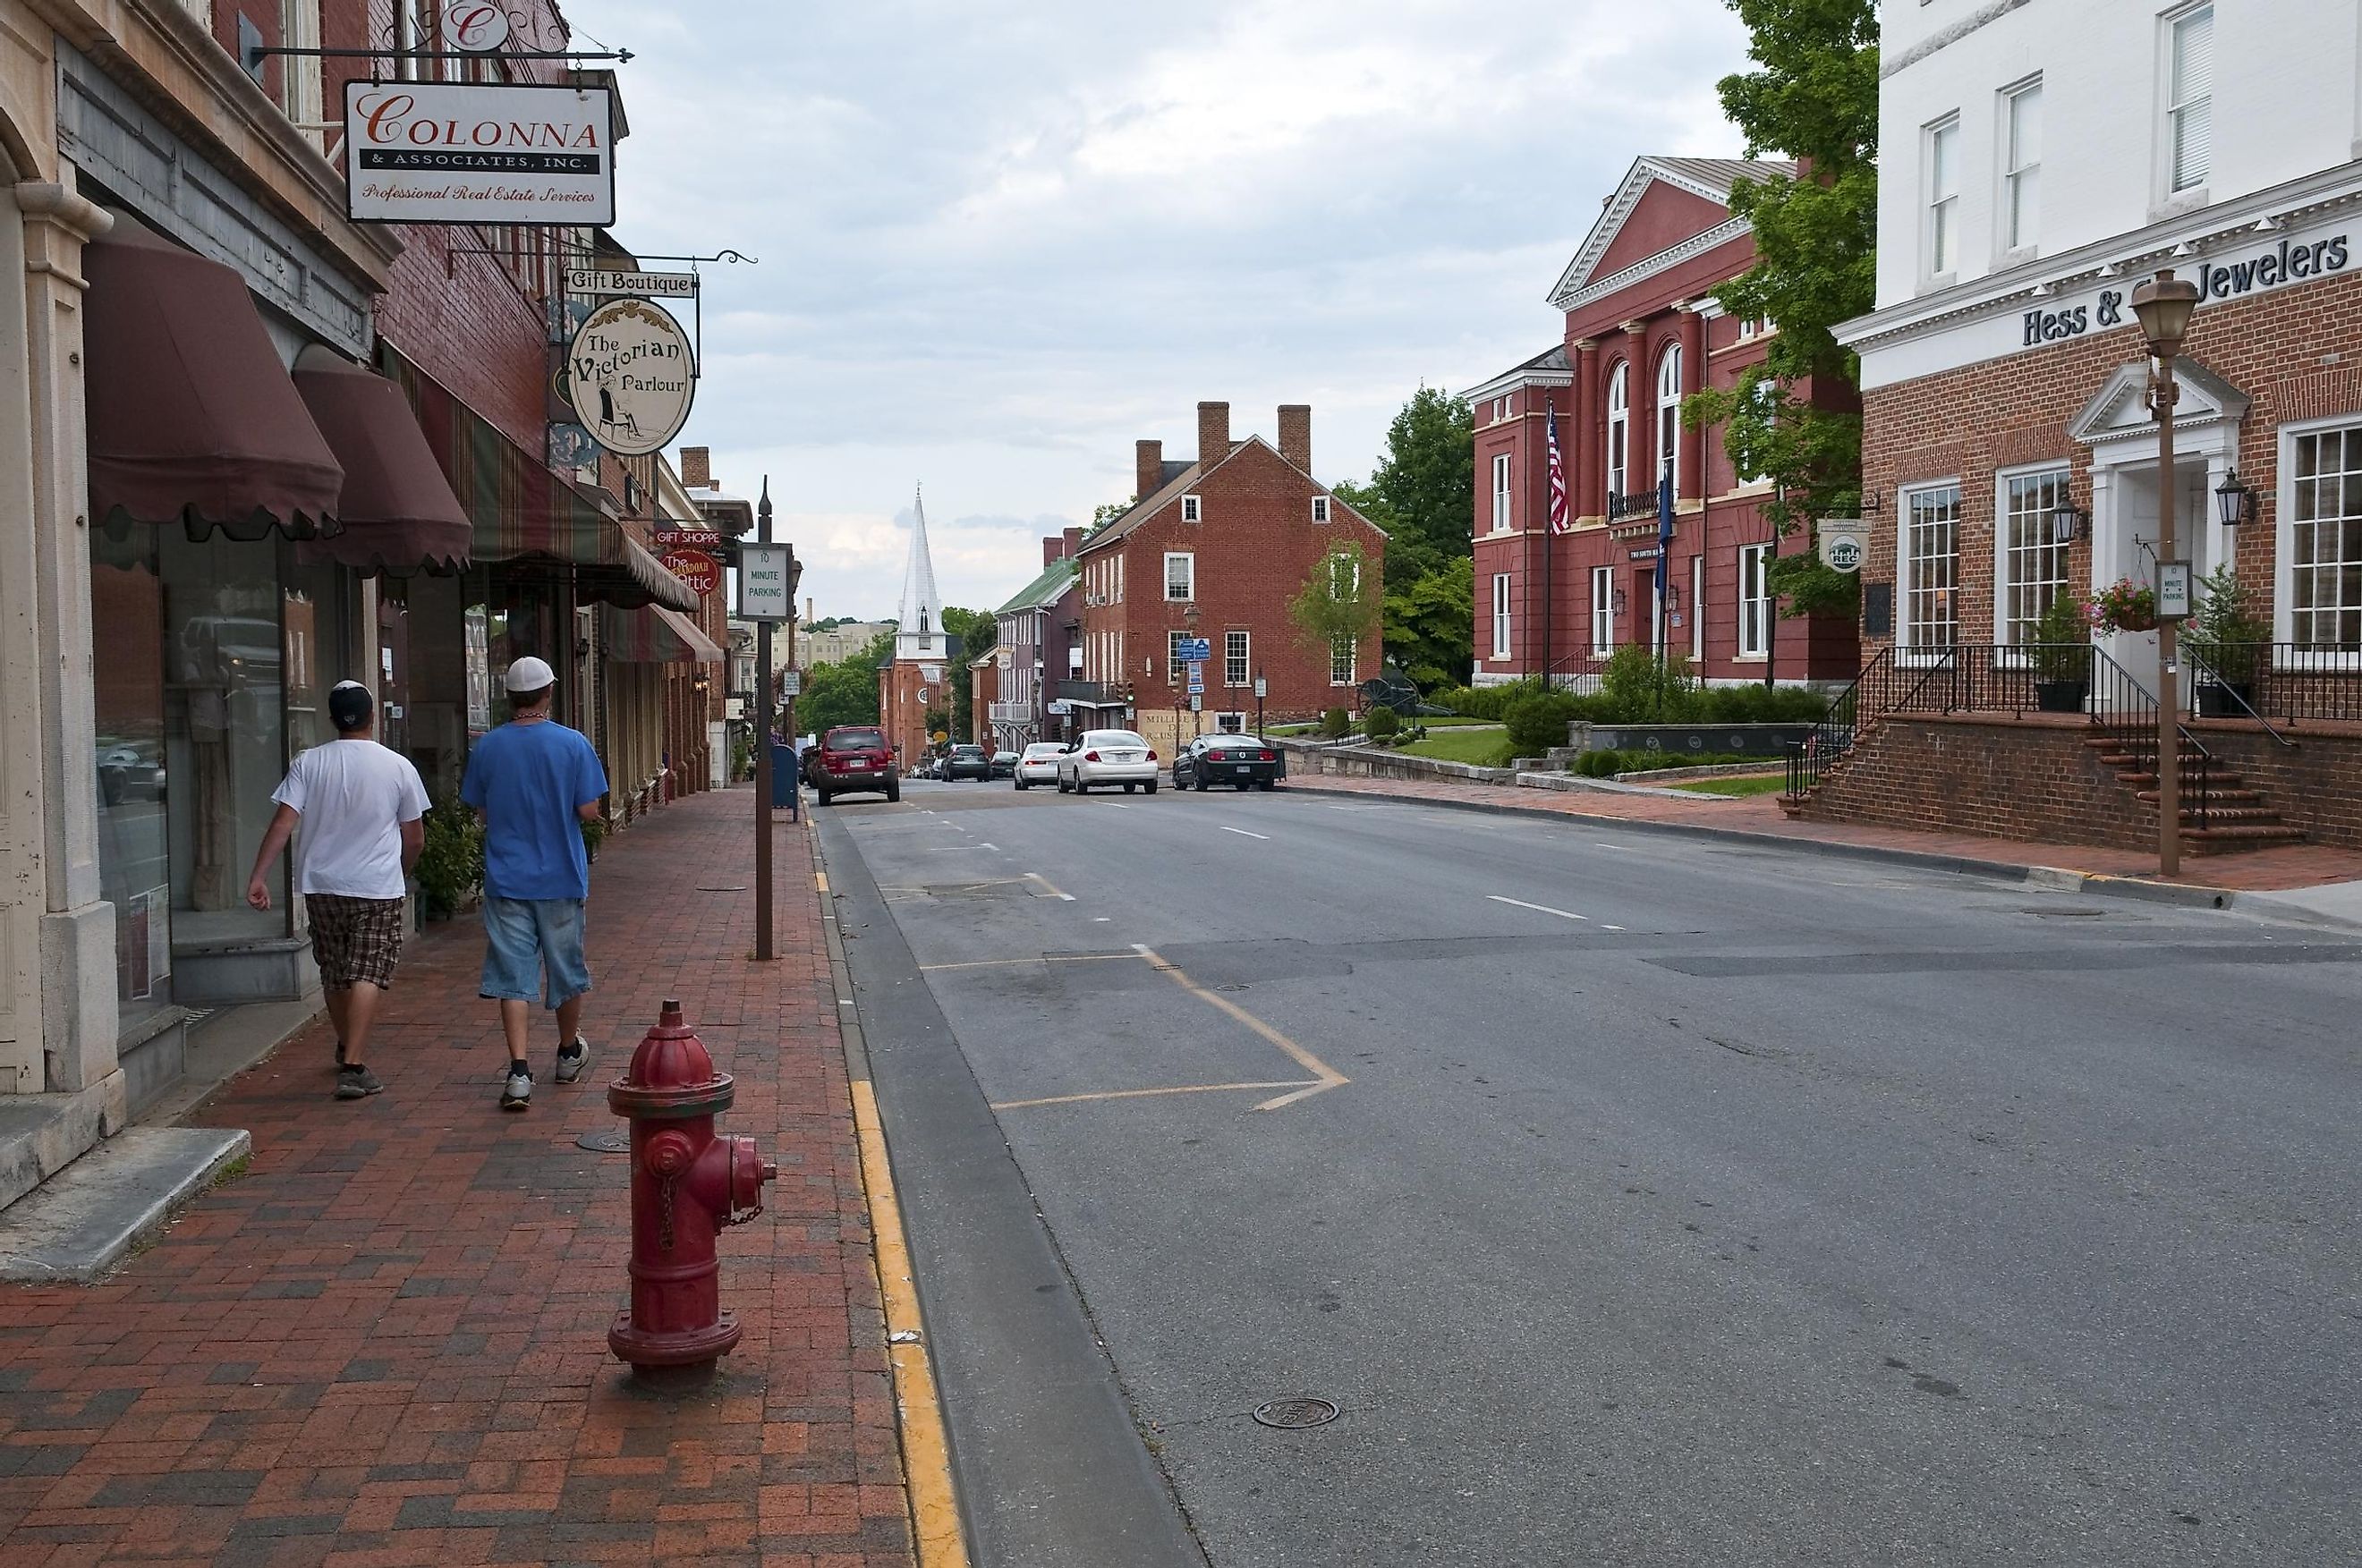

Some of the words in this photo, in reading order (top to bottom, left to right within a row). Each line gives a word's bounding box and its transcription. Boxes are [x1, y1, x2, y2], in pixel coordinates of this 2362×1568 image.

[356, 92, 600, 148] COLONNA
[371, 153, 383, 164] &
[394, 154, 535, 168] ASSOCIATES,
[544, 157, 588, 169] INC.
[361, 184, 449, 205] Professional
[453, 186, 492, 200] Real
[494, 187, 536, 201] Estate
[539, 187, 595, 202] Services
[572, 271, 607, 291] Gift
[611, 273, 689, 293] Boutique
[2022, 304, 2087, 346] Hess
[2096, 290, 2122, 326] &
[2196, 234, 2349, 303] Jewelers
[587, 335, 620, 353] The
[572, 339, 680, 383] Victorian
[621, 374, 685, 392] Parlour
[657, 531, 679, 543] GIFT
[681, 532, 720, 544] SHOPPE
[665, 555, 688, 568] The
[760, 553, 769, 563] 10
[751, 571, 779, 581] MINUTE
[749, 587, 782, 598] PARKING
